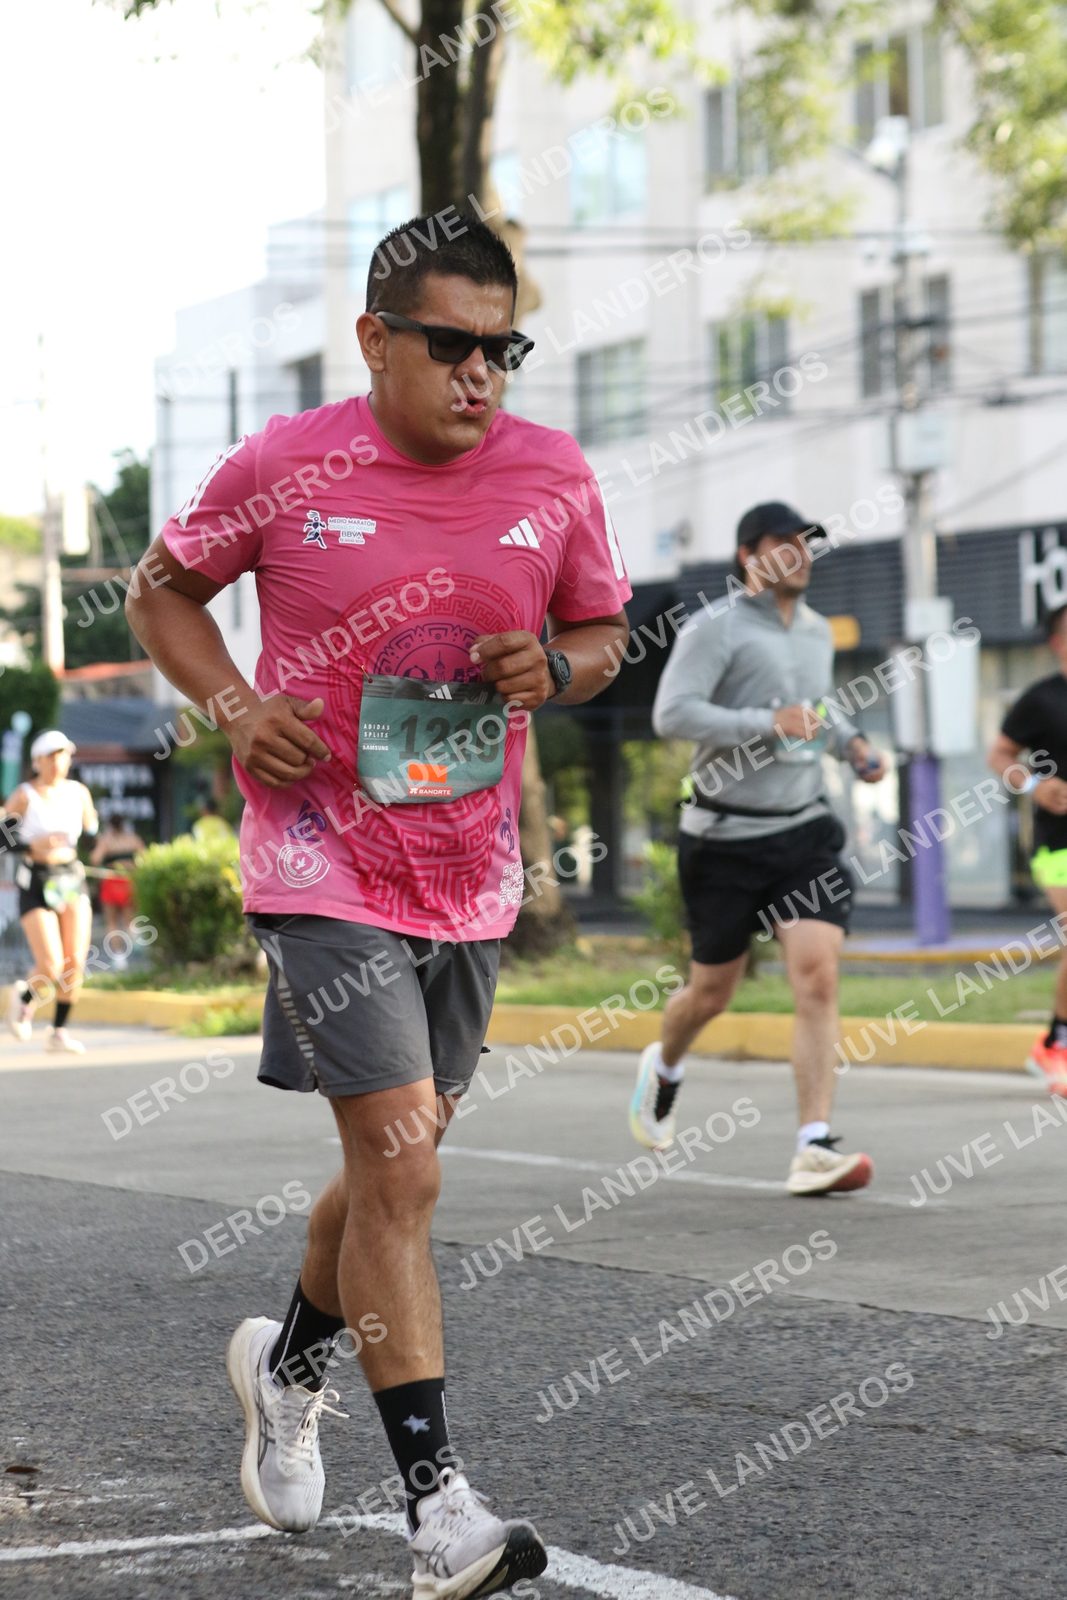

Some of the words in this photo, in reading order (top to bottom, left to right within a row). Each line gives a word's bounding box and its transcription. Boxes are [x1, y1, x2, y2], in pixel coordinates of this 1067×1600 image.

[342, 530, 362, 538] BBVA
[363, 723, 390, 731] ADIDAS
[363, 731, 389, 739] SPLITS
[418, 788, 452, 796] BANORTE
